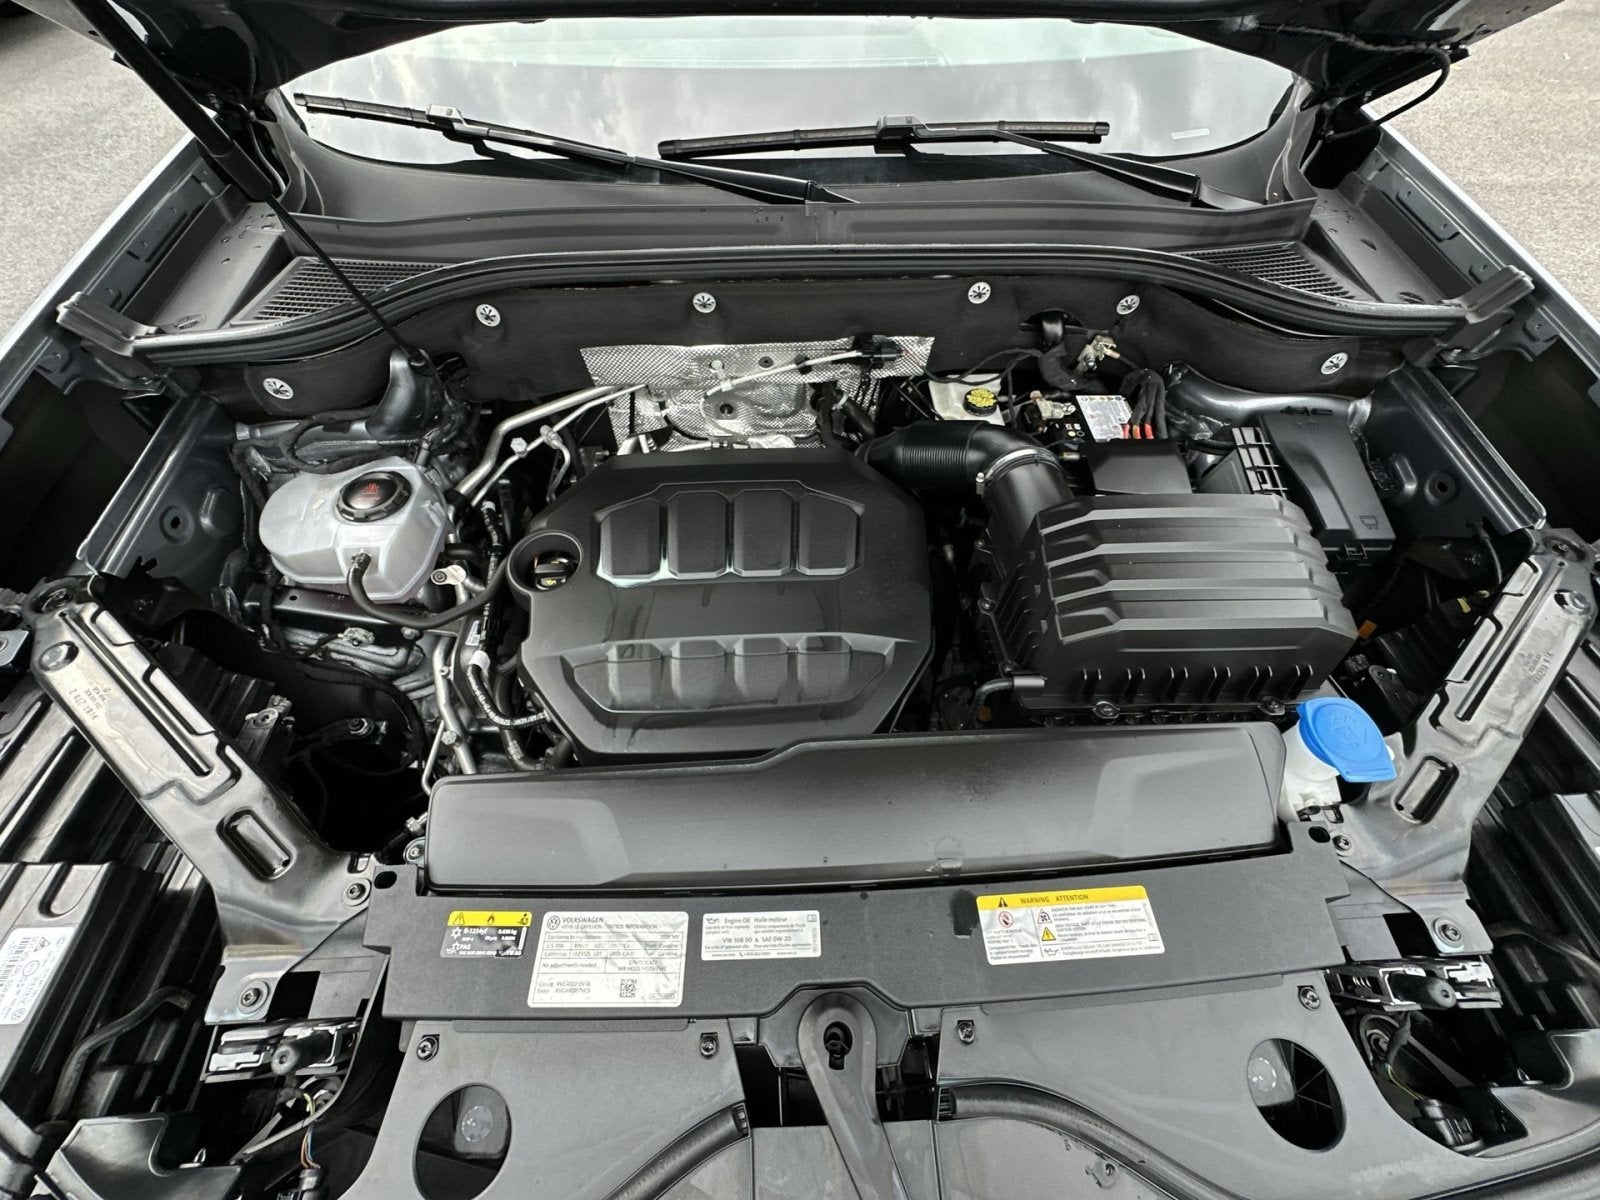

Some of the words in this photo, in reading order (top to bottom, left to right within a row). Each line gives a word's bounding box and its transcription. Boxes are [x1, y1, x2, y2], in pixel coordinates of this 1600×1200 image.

[1020, 896, 1050, 904] WARNING
[1055, 894, 1089, 902] ATTENTION
[724, 917, 741, 925] Engine
